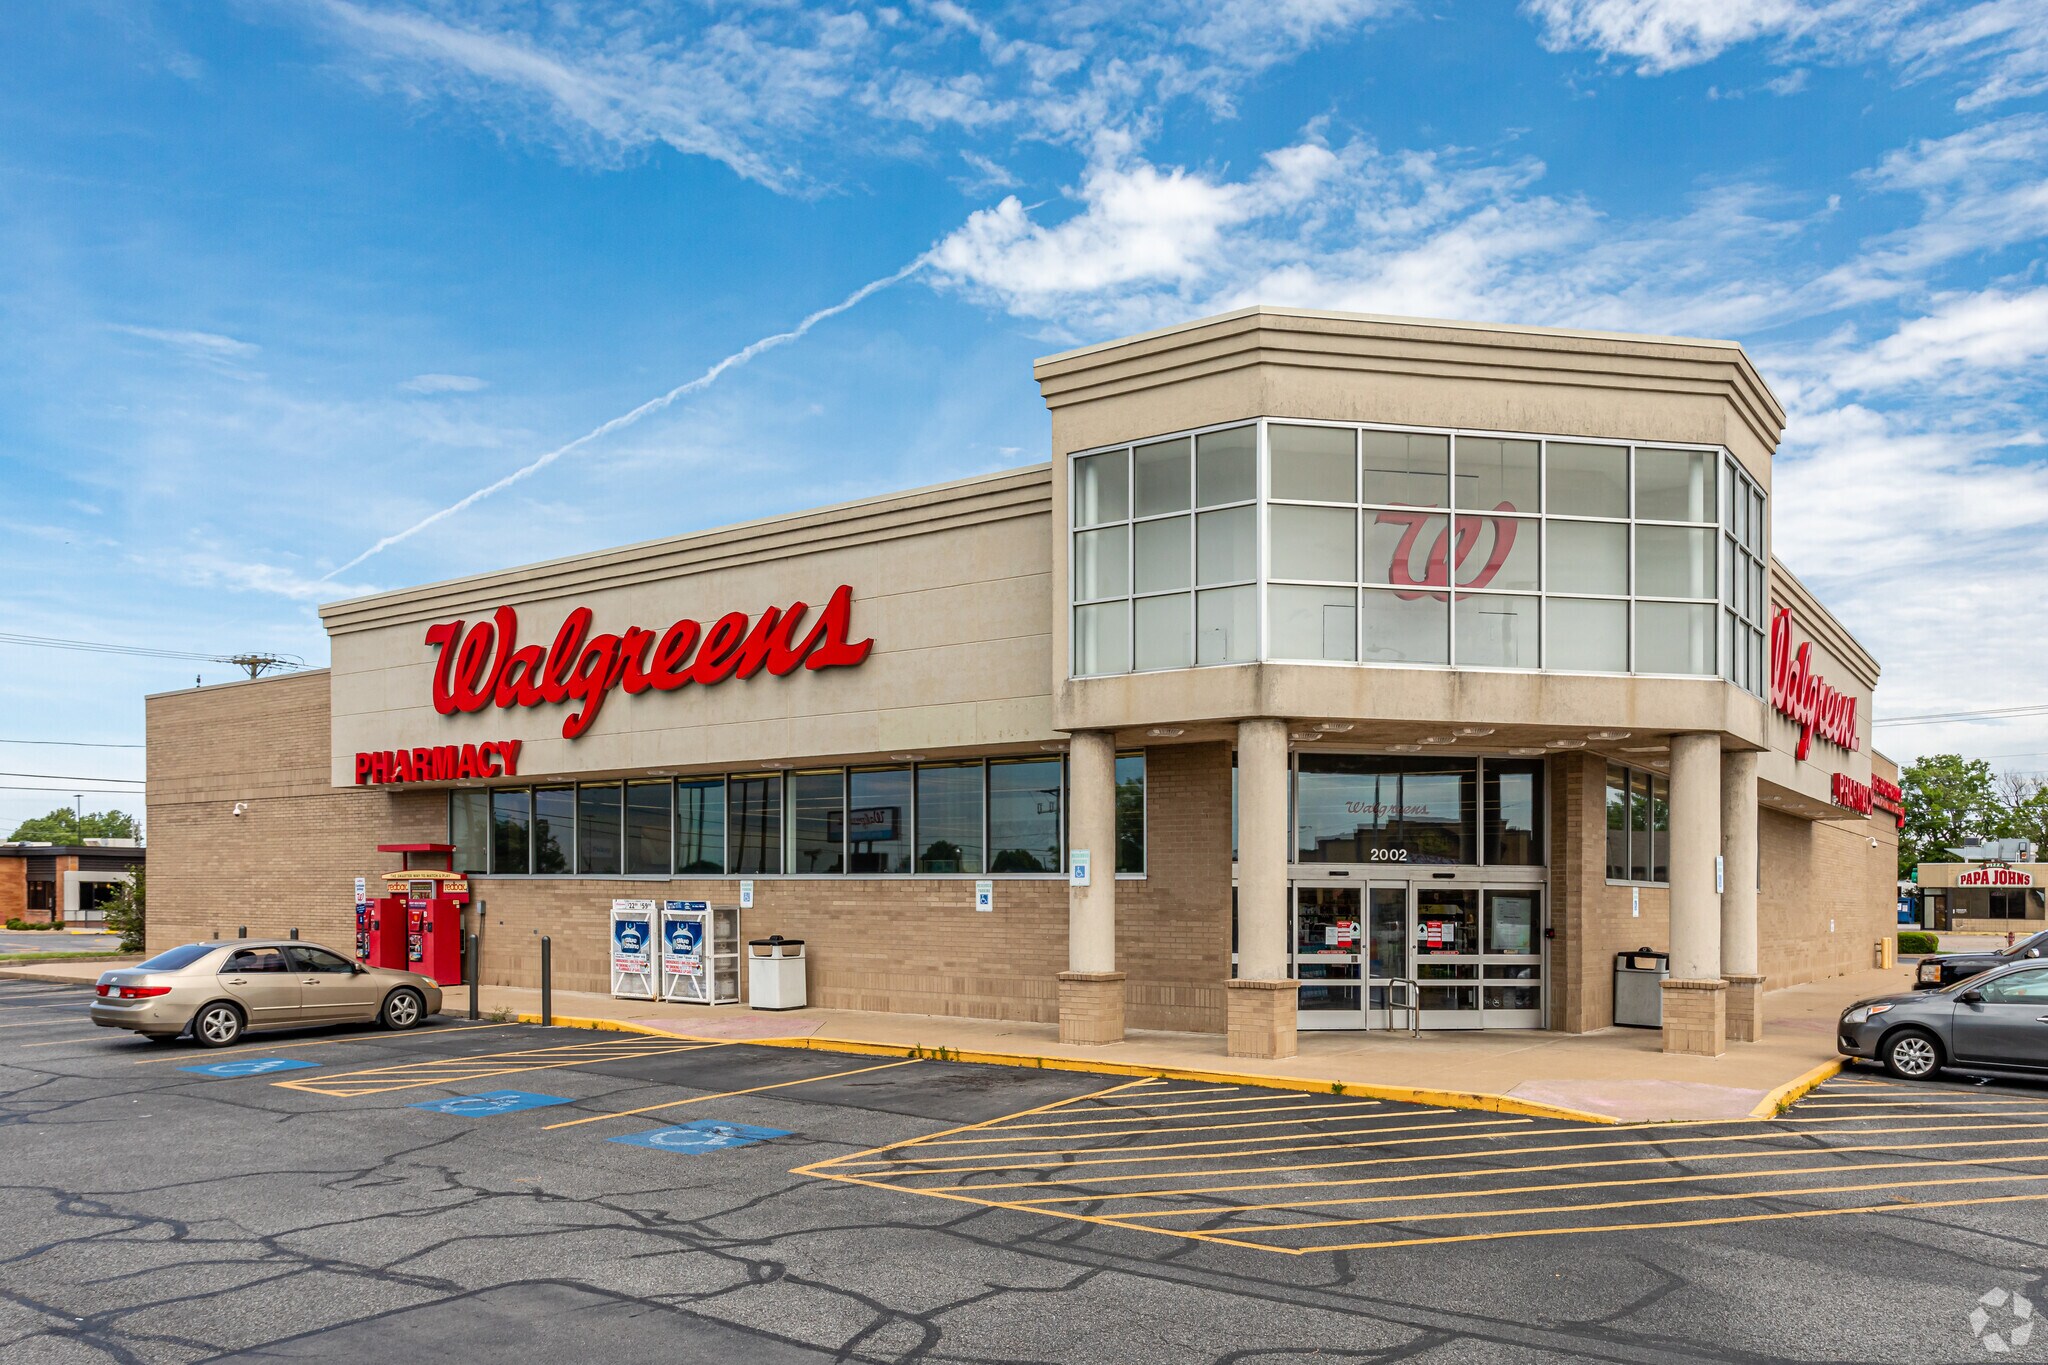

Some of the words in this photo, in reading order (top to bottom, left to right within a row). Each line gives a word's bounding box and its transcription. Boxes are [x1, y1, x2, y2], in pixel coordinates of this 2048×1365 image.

[1374, 501, 1517, 602] W
[425, 584, 873, 740] Walgreens
[1771, 604, 1860, 761] Walgreens
[355, 740, 522, 785] PHARMACY
[1345, 801, 1429, 818] Walgreens
[1370, 848, 1408, 861] 2002
[1960, 870, 1990, 885] PAPA
[1992, 870, 2031, 886] JOHNS
